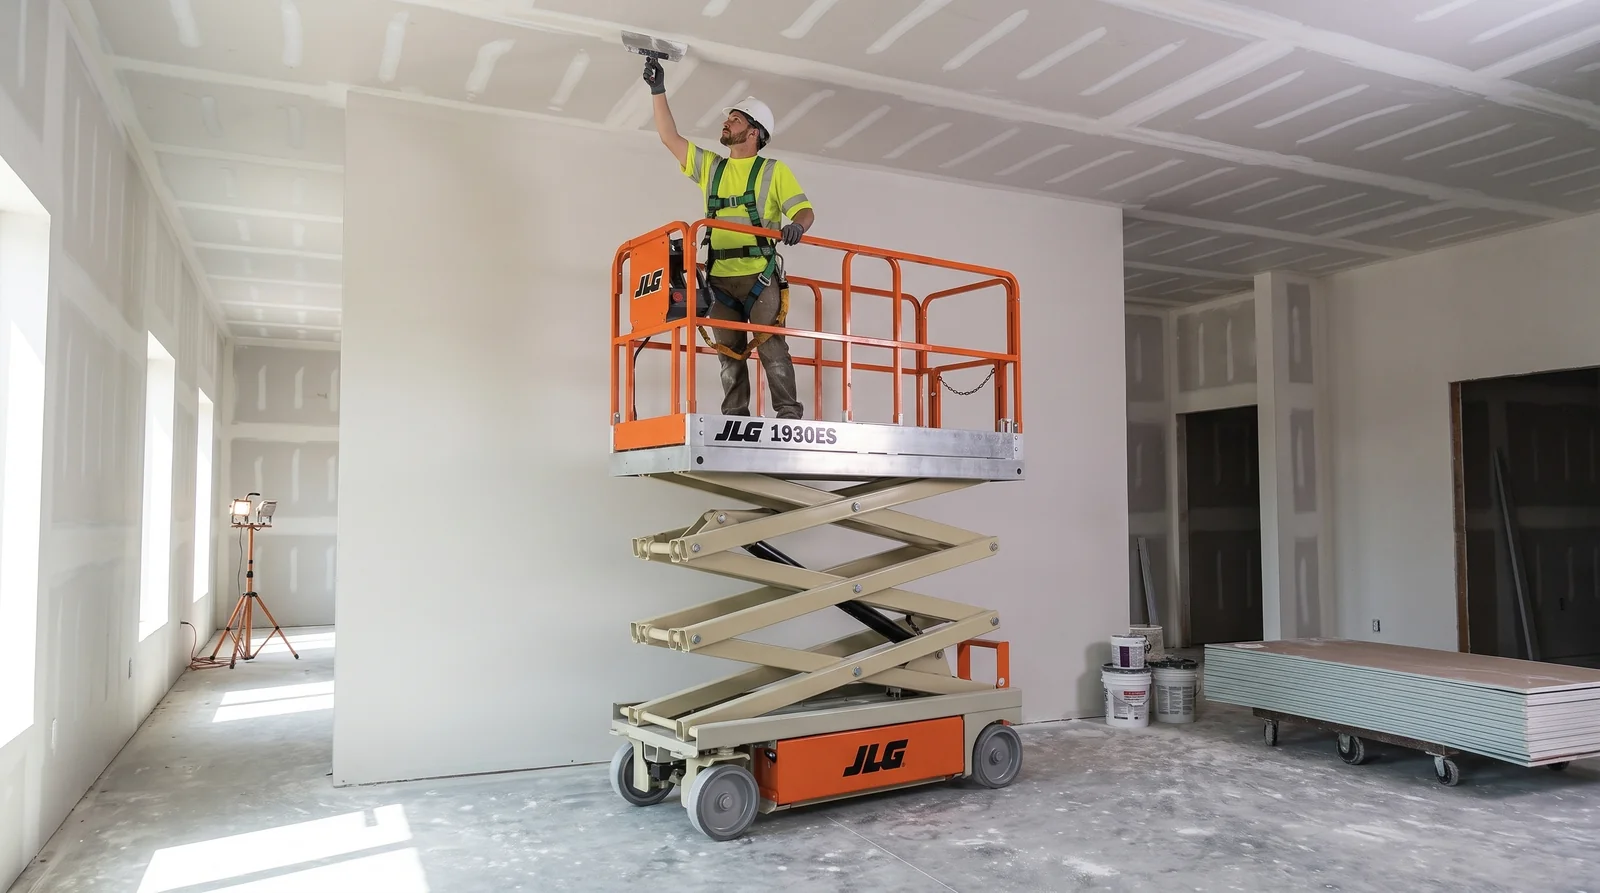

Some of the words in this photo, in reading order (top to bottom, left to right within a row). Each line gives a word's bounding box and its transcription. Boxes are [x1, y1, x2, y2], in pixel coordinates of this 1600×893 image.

[634, 268, 664, 299] JLG
[714, 420, 764, 442] JLG
[771, 424, 837, 444] 1930ES
[842, 739, 908, 777] JLG
